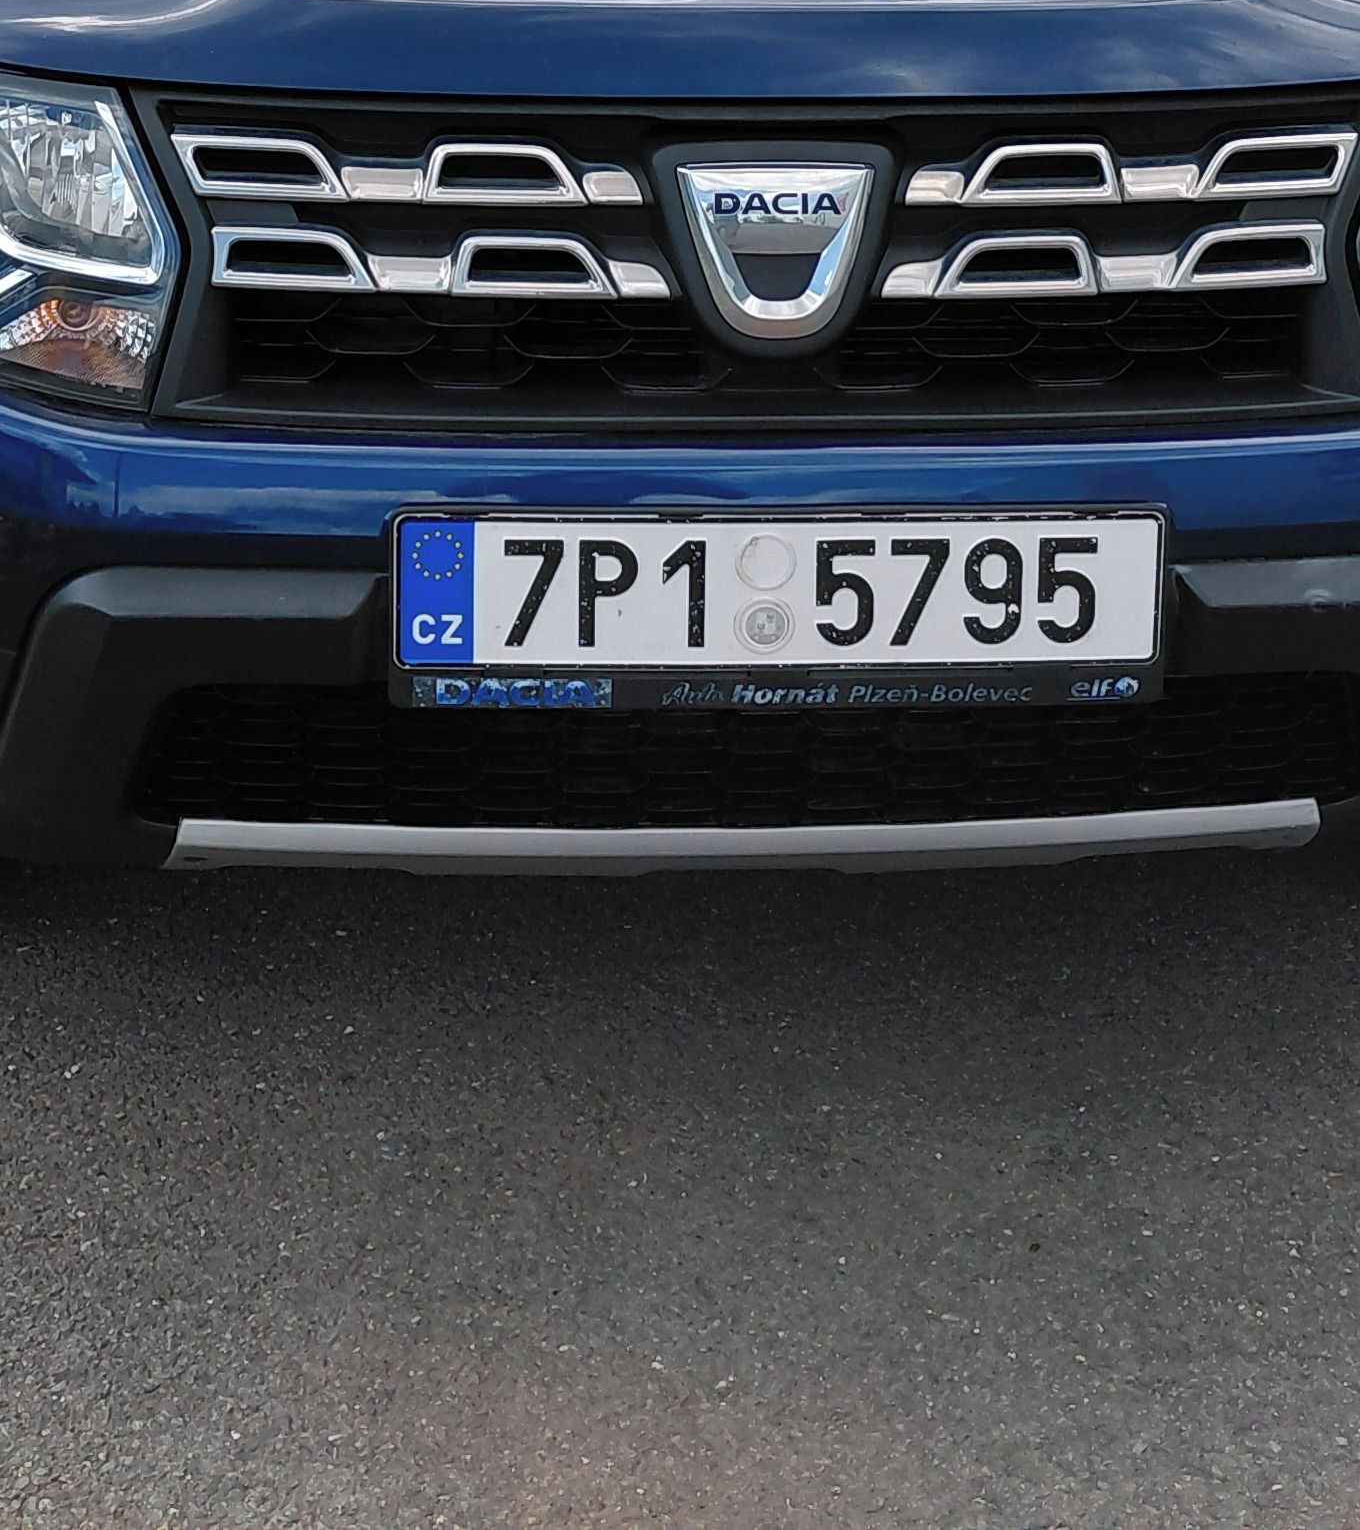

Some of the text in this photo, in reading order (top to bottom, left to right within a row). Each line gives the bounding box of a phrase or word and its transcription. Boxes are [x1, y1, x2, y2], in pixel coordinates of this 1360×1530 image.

[713, 192, 842, 215] DACIA
[504, 536, 1098, 648] 7P1 5795
[410, 613, 464, 645] CZ
[435, 678, 598, 707] DACIA
[730, 682, 839, 705] Hornát
[847, 683, 1034, 704] Plzeň-Bolevec
[1070, 678, 1115, 699] elf
